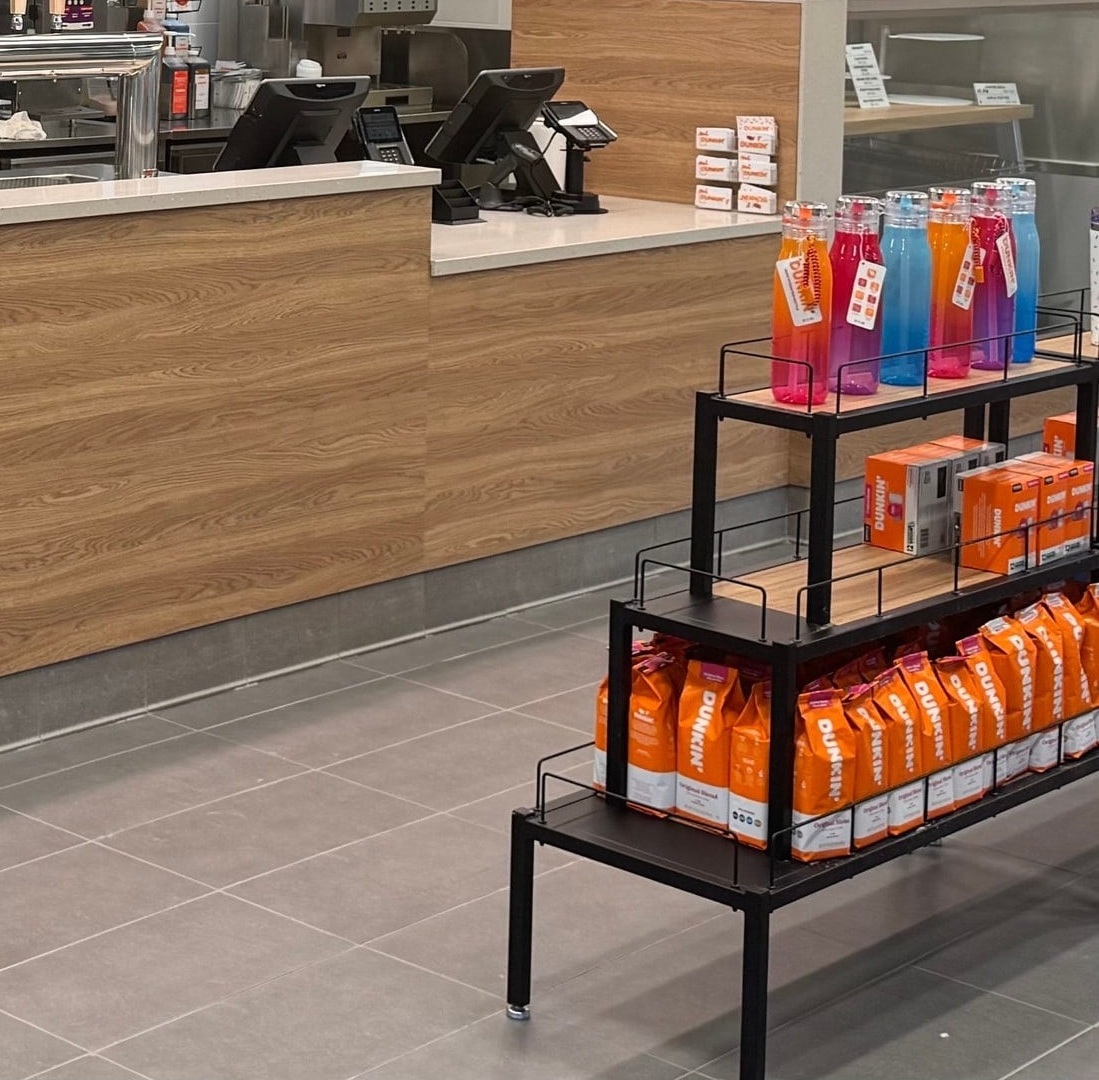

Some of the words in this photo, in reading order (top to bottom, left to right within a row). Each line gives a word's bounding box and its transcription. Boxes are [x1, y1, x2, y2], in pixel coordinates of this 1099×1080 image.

[875, 475, 886, 531] DUNKIN'
[914, 681, 944, 760] DUNKIN'
[1009, 634, 1032, 730] DUNKIN'
[690, 690, 717, 773] DUNKIN'
[817, 718, 844, 802] DUNKIN'
[888, 694, 914, 772] DUNKIN'
